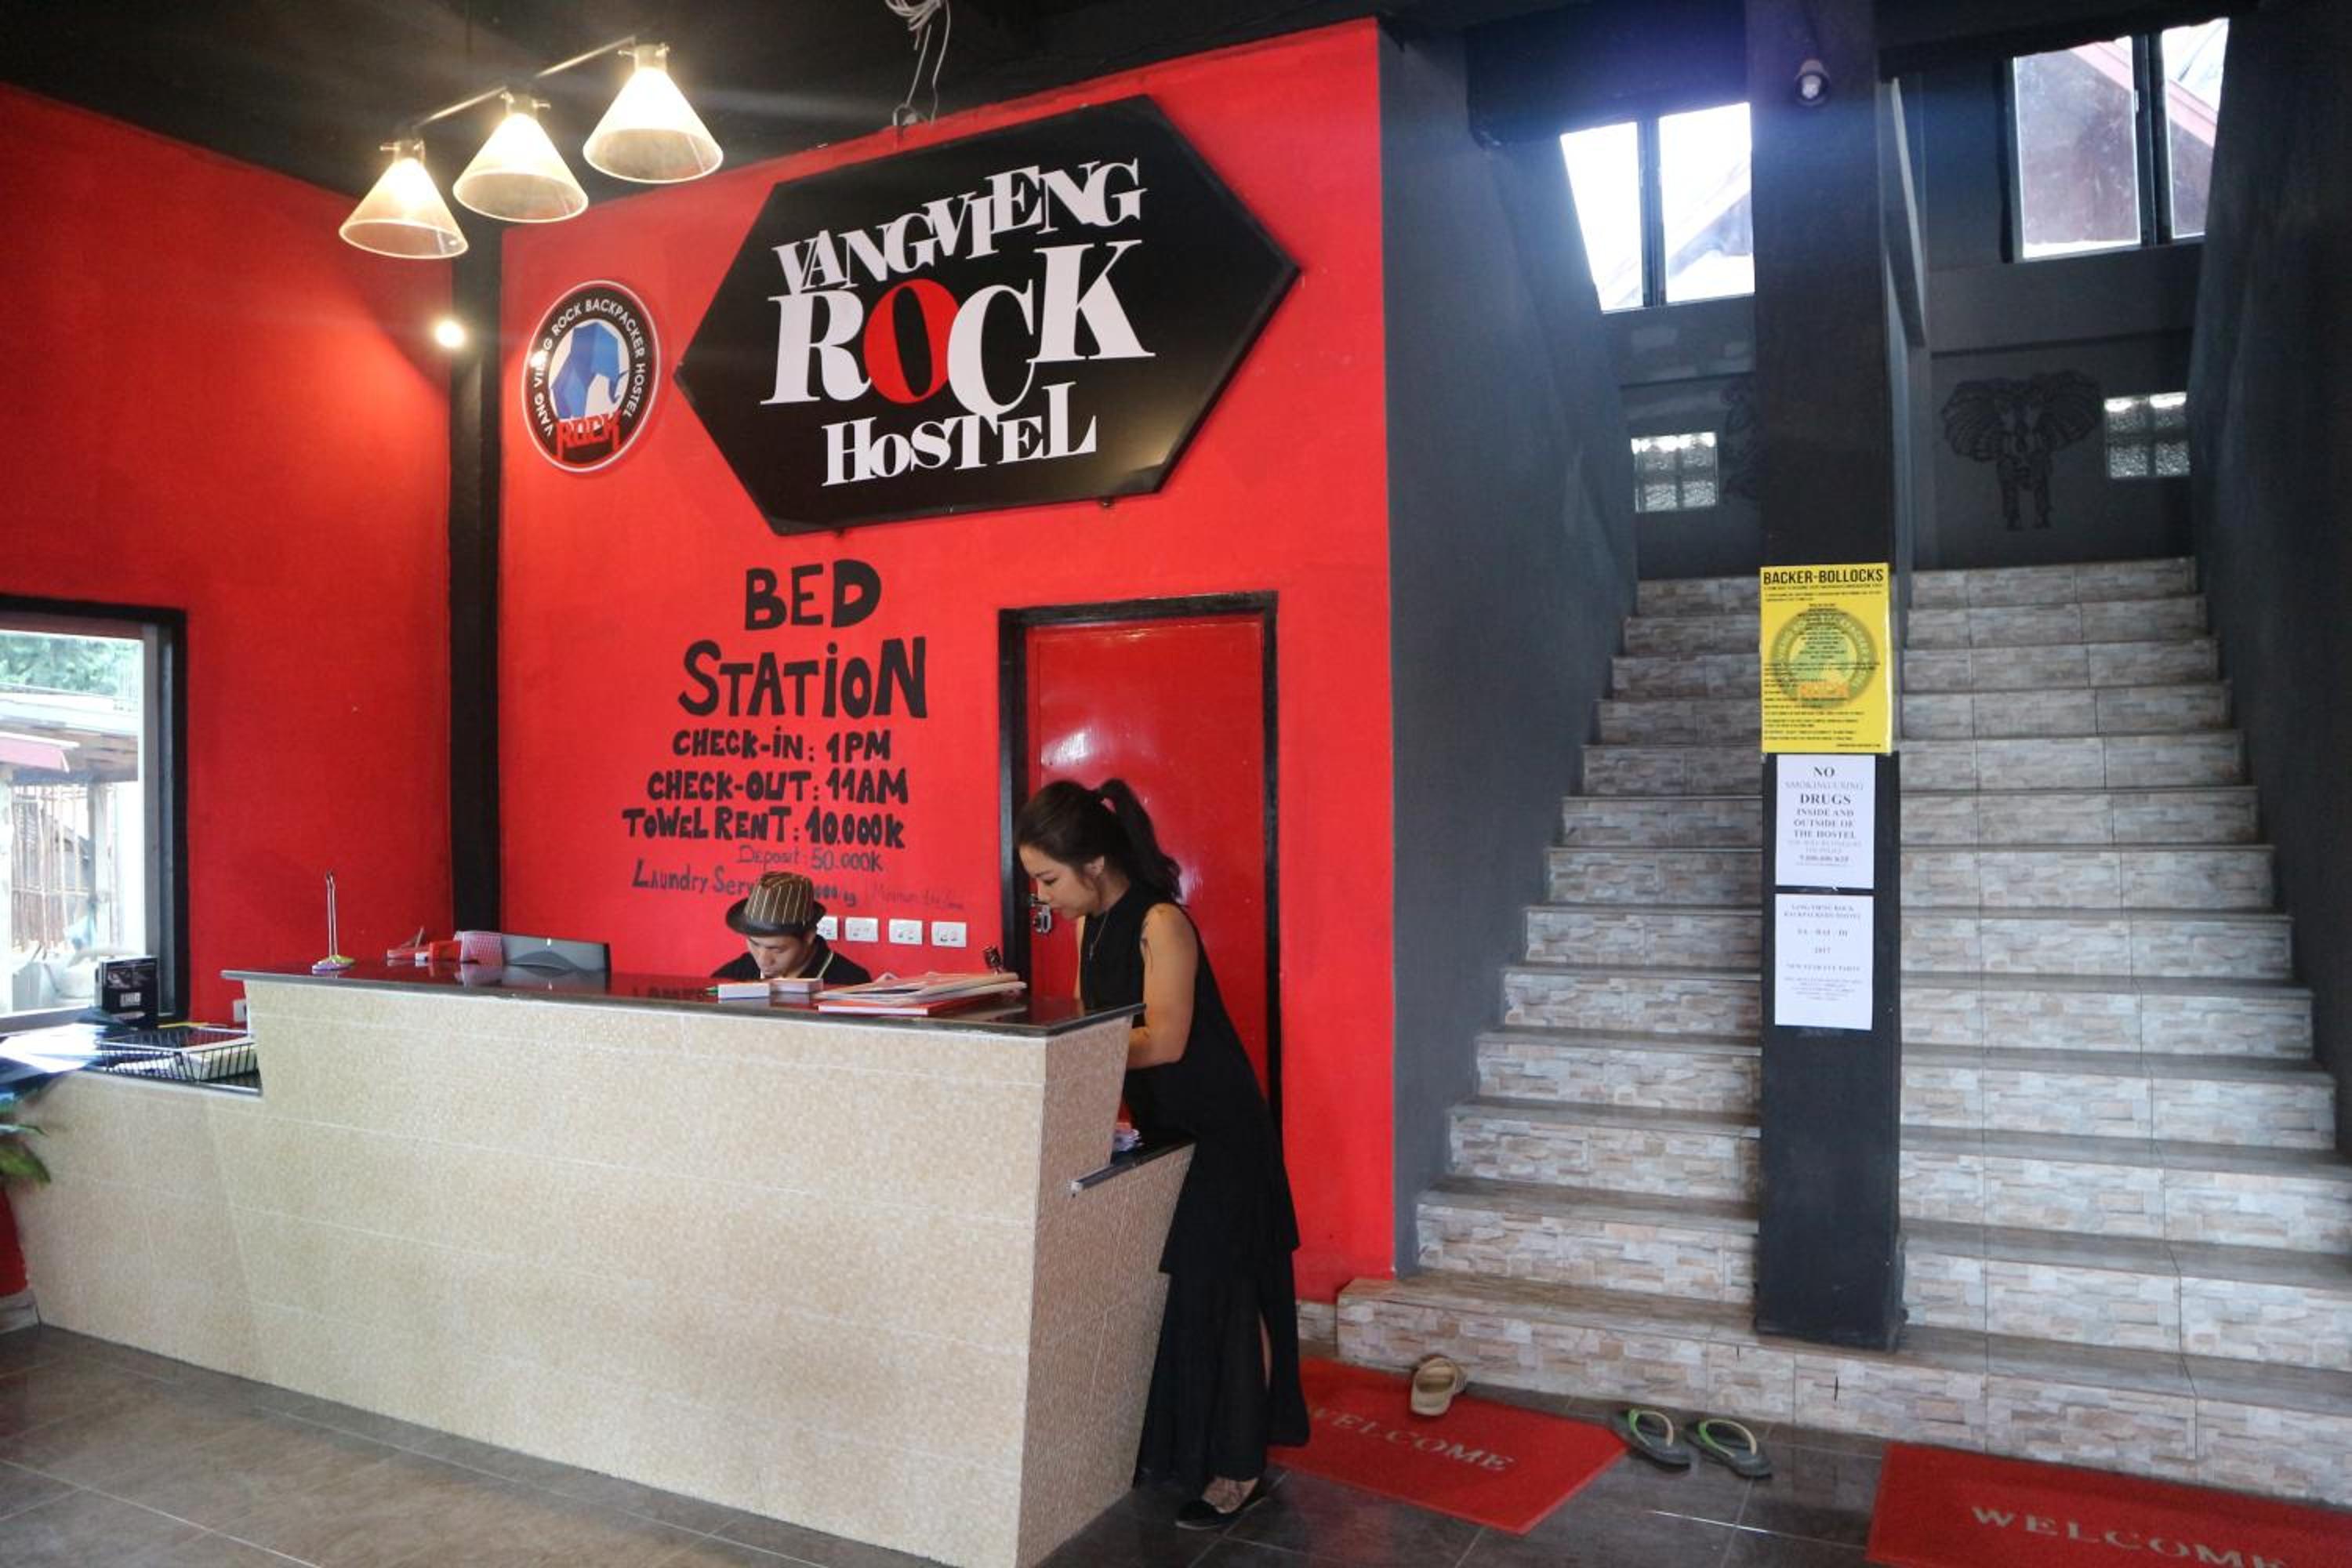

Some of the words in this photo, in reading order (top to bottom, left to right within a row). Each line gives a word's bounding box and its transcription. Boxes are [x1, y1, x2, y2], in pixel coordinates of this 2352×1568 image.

[772, 158, 1147, 295] VANGVIENG
[551, 303, 583, 336] ROCK
[585, 299, 645, 358] BACKPACKER
[760, 240, 1155, 416] ROCK
[534, 337, 553, 388] VIG
[622, 363, 645, 419] HOSTEL
[534, 395, 554, 437] VANG
[821, 382, 1097, 487] HOSTEL
[745, 559, 881, 630] BED
[826, 729, 891, 764] 1PM
[826, 767, 909, 804] 11AM
[1813, 766, 1835, 777] NO
[1801, 793, 1851, 804] DRUGS
[1817, 830, 1857, 839] HOSTEL
